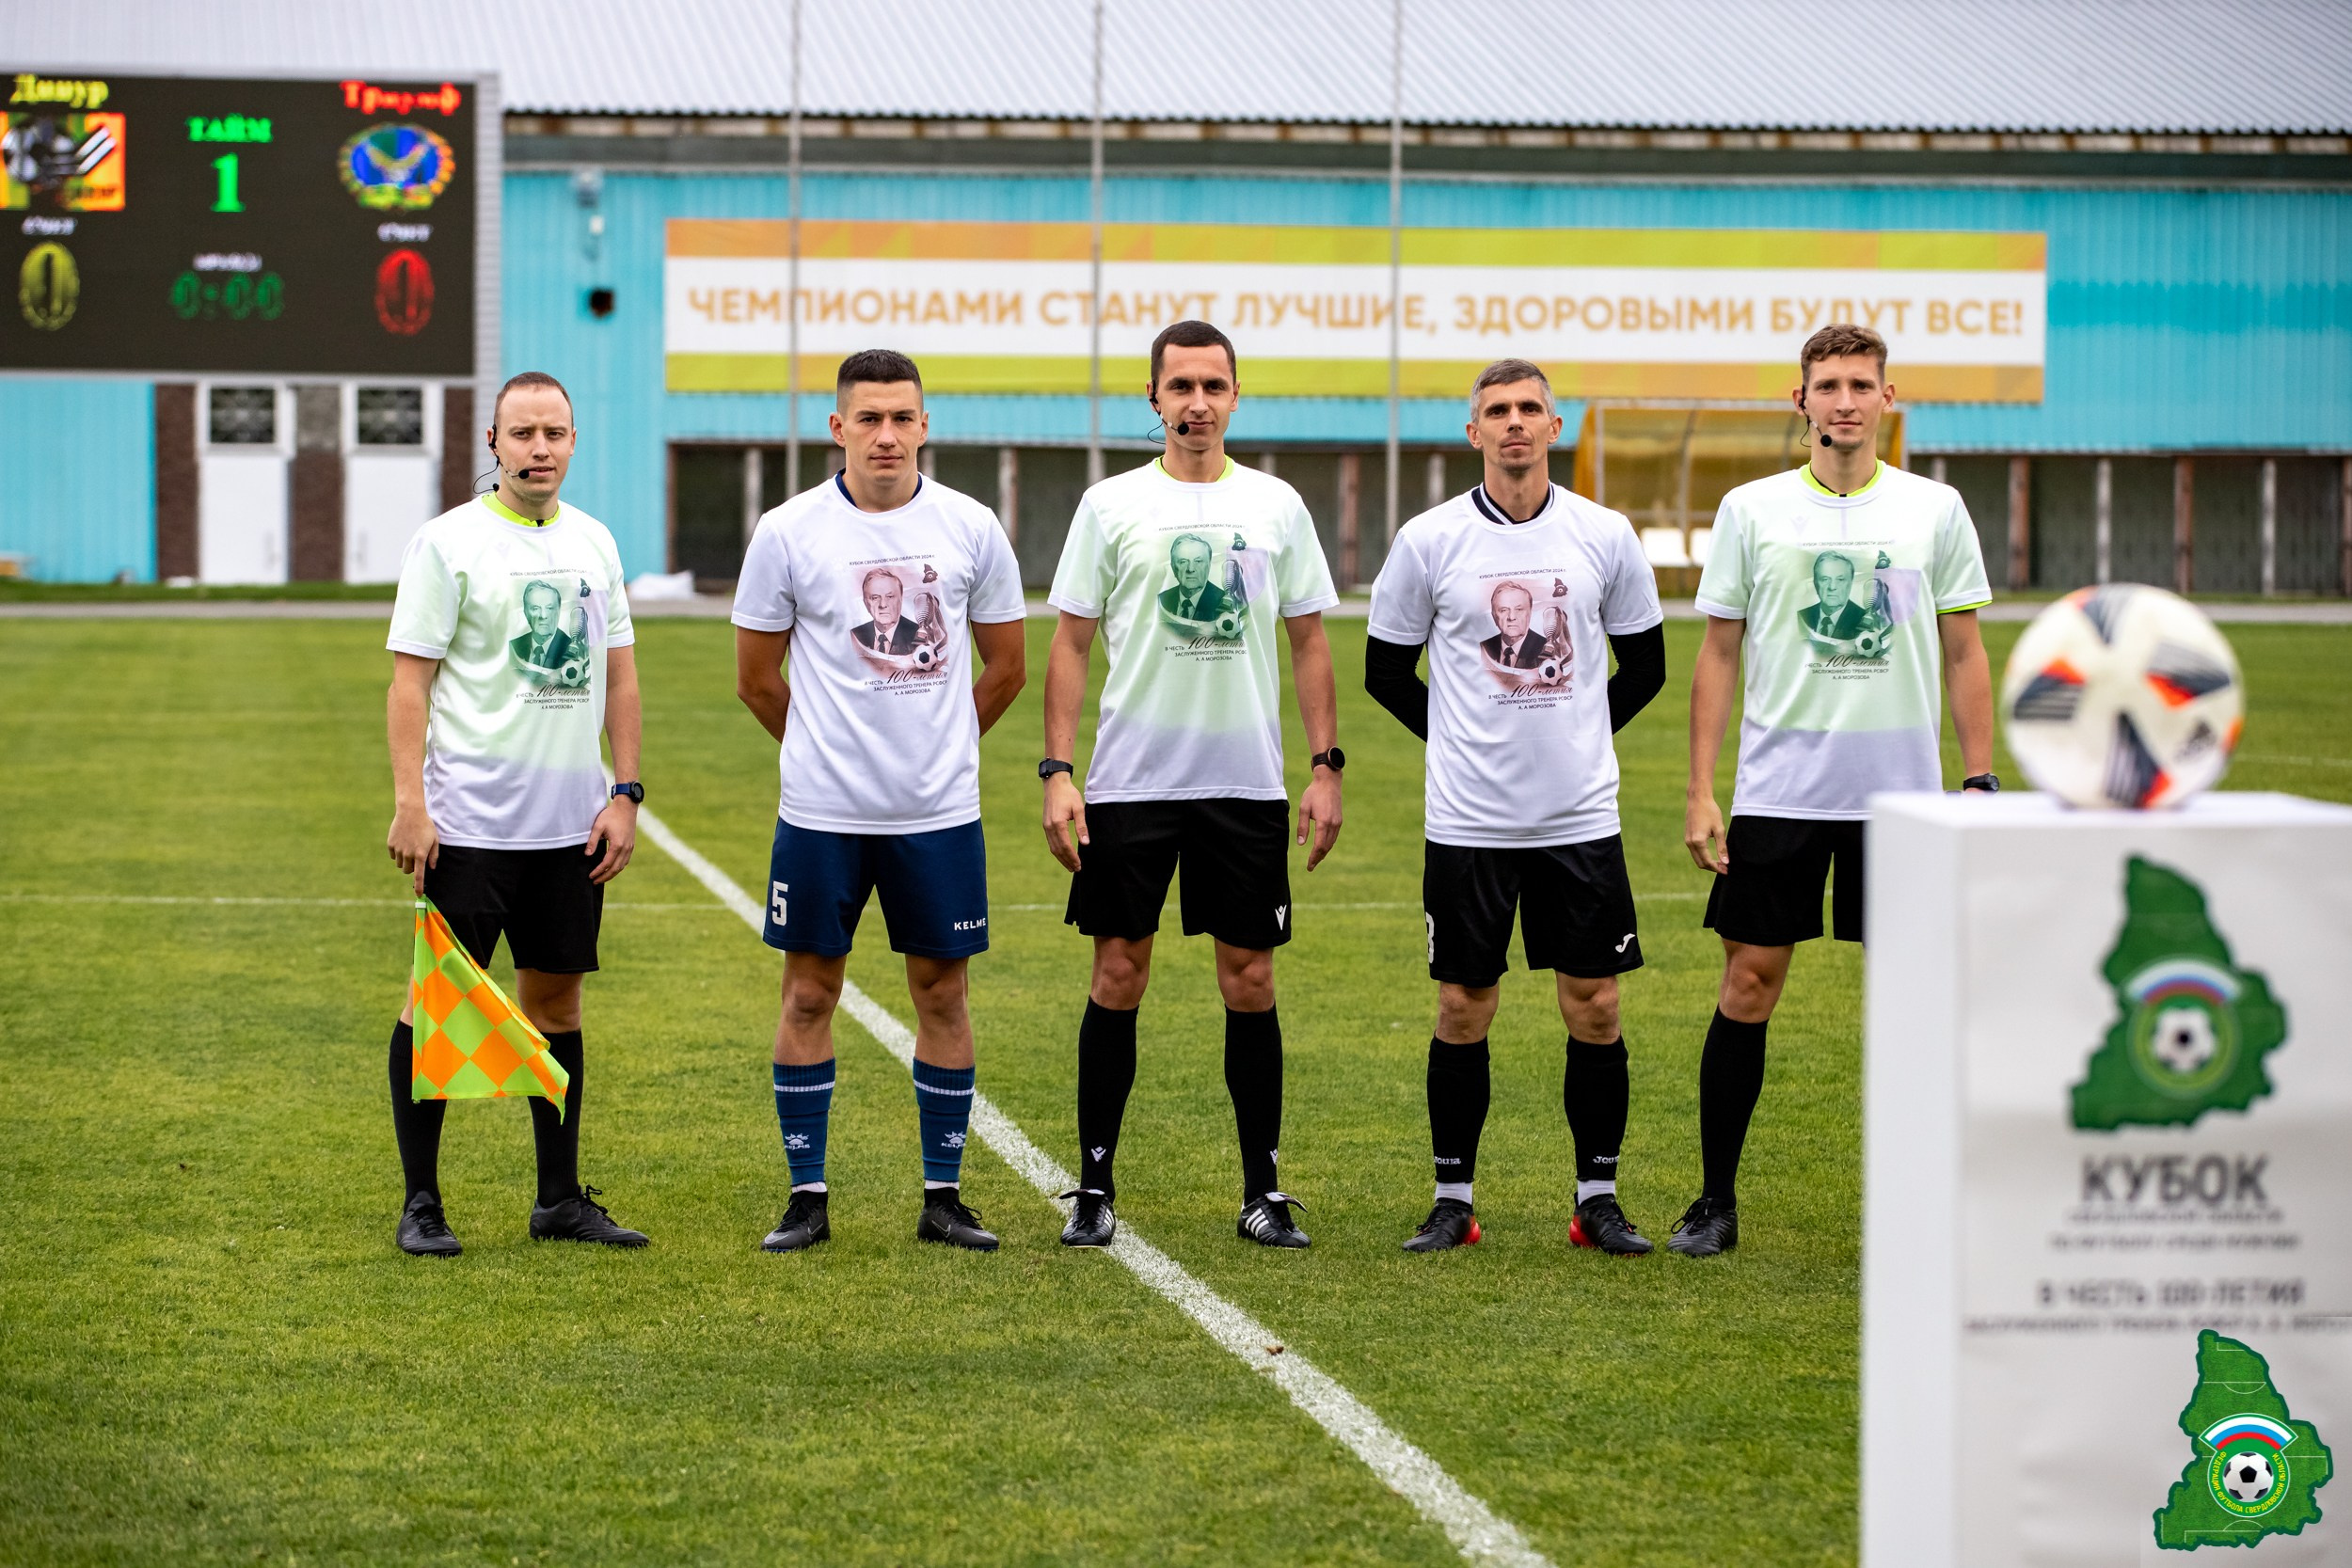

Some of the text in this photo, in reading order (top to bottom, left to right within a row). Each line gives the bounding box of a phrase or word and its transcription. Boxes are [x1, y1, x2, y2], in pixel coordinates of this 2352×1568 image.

[211, 151, 246, 213] 1
[19, 242, 80, 331] 0
[170, 270, 284, 321] 0:00
[375, 248, 434, 336] 0
[688, 289, 2024, 337] ЧЕМПИОНАМИ СТАНУТ ЛУЧШИЕ, ЗДОРОВЫМИ БУДУТ ВСЕ!
[873, 684, 913, 692] ЗАСЛУЖЕННОГО
[772, 880, 789, 927] 5
[954, 917, 986, 931] KELME
[2081, 1154, 2269, 1206] КУБОК
